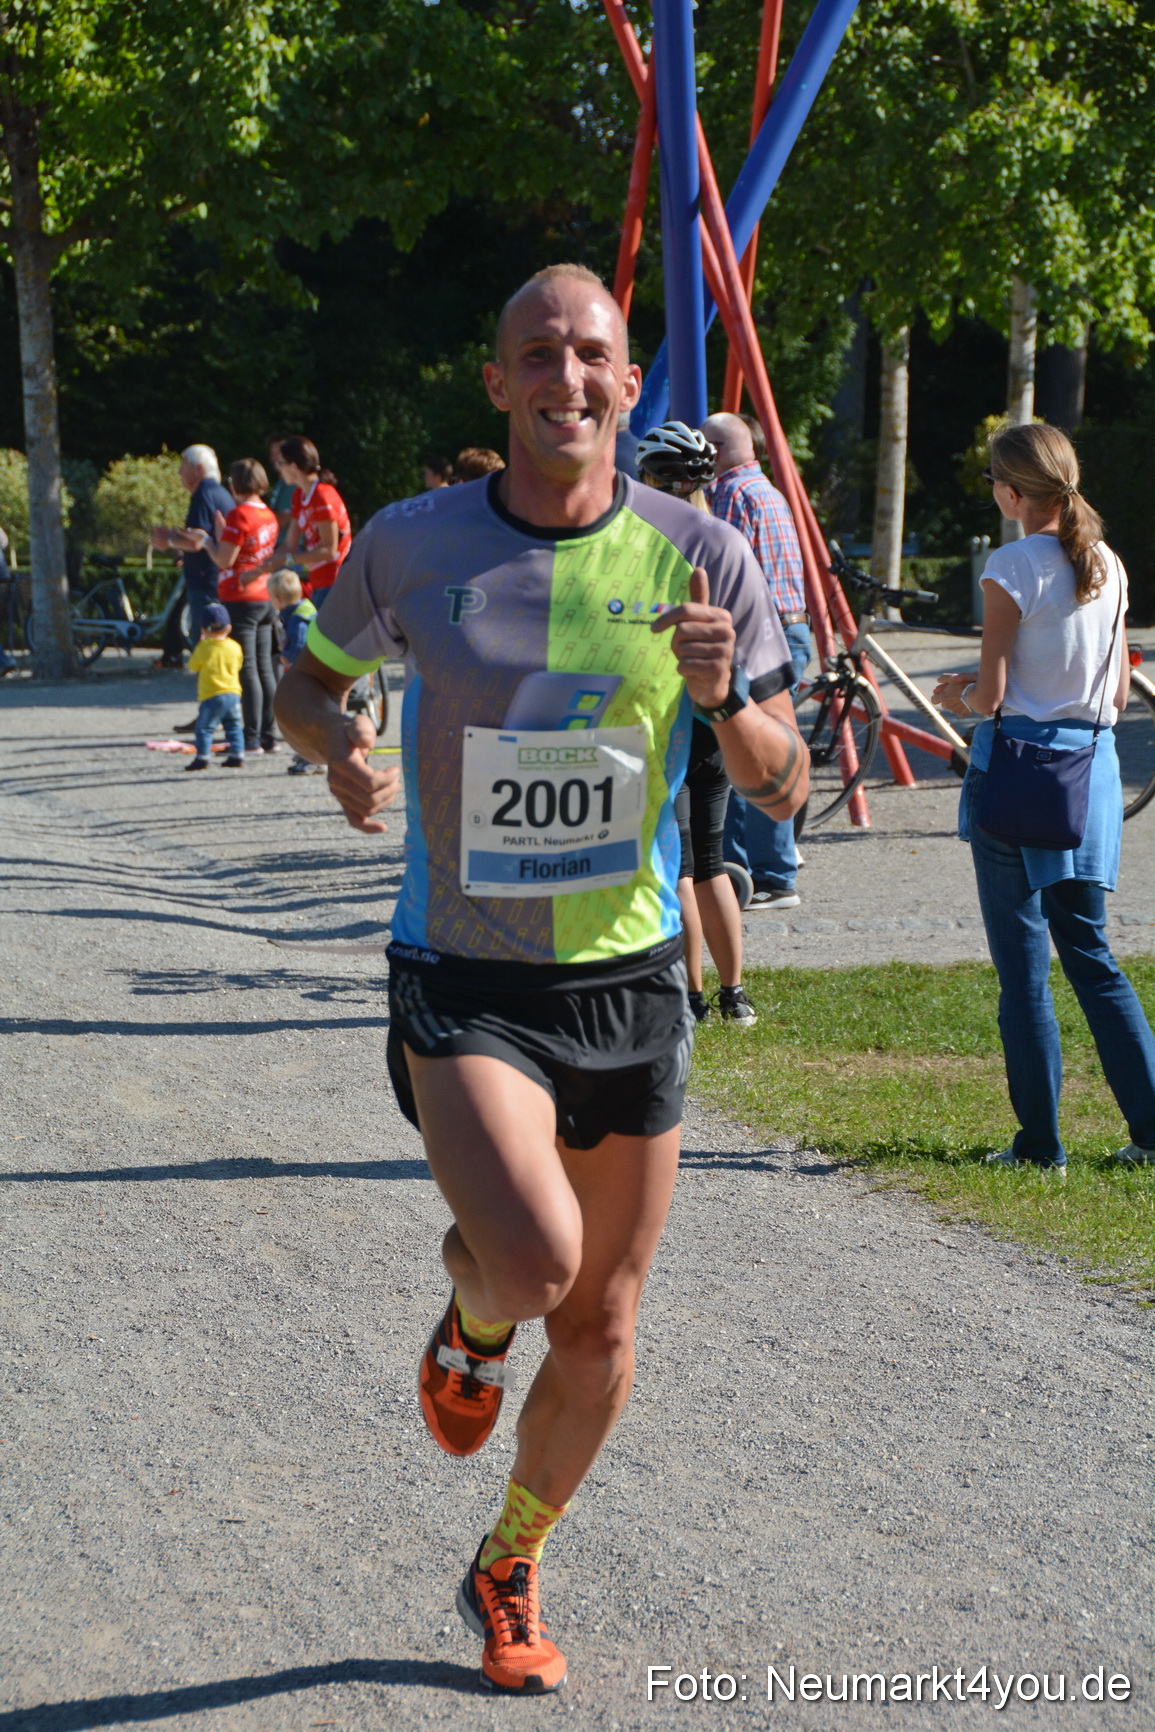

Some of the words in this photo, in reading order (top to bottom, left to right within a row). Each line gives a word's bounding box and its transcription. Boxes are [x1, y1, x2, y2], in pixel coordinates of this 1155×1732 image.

[518, 746, 598, 765] BOCK
[491, 776, 613, 828] 2001
[503, 836, 540, 846] PARTL
[543, 834, 594, 846] Neumarkt
[519, 857, 591, 879] Florian
